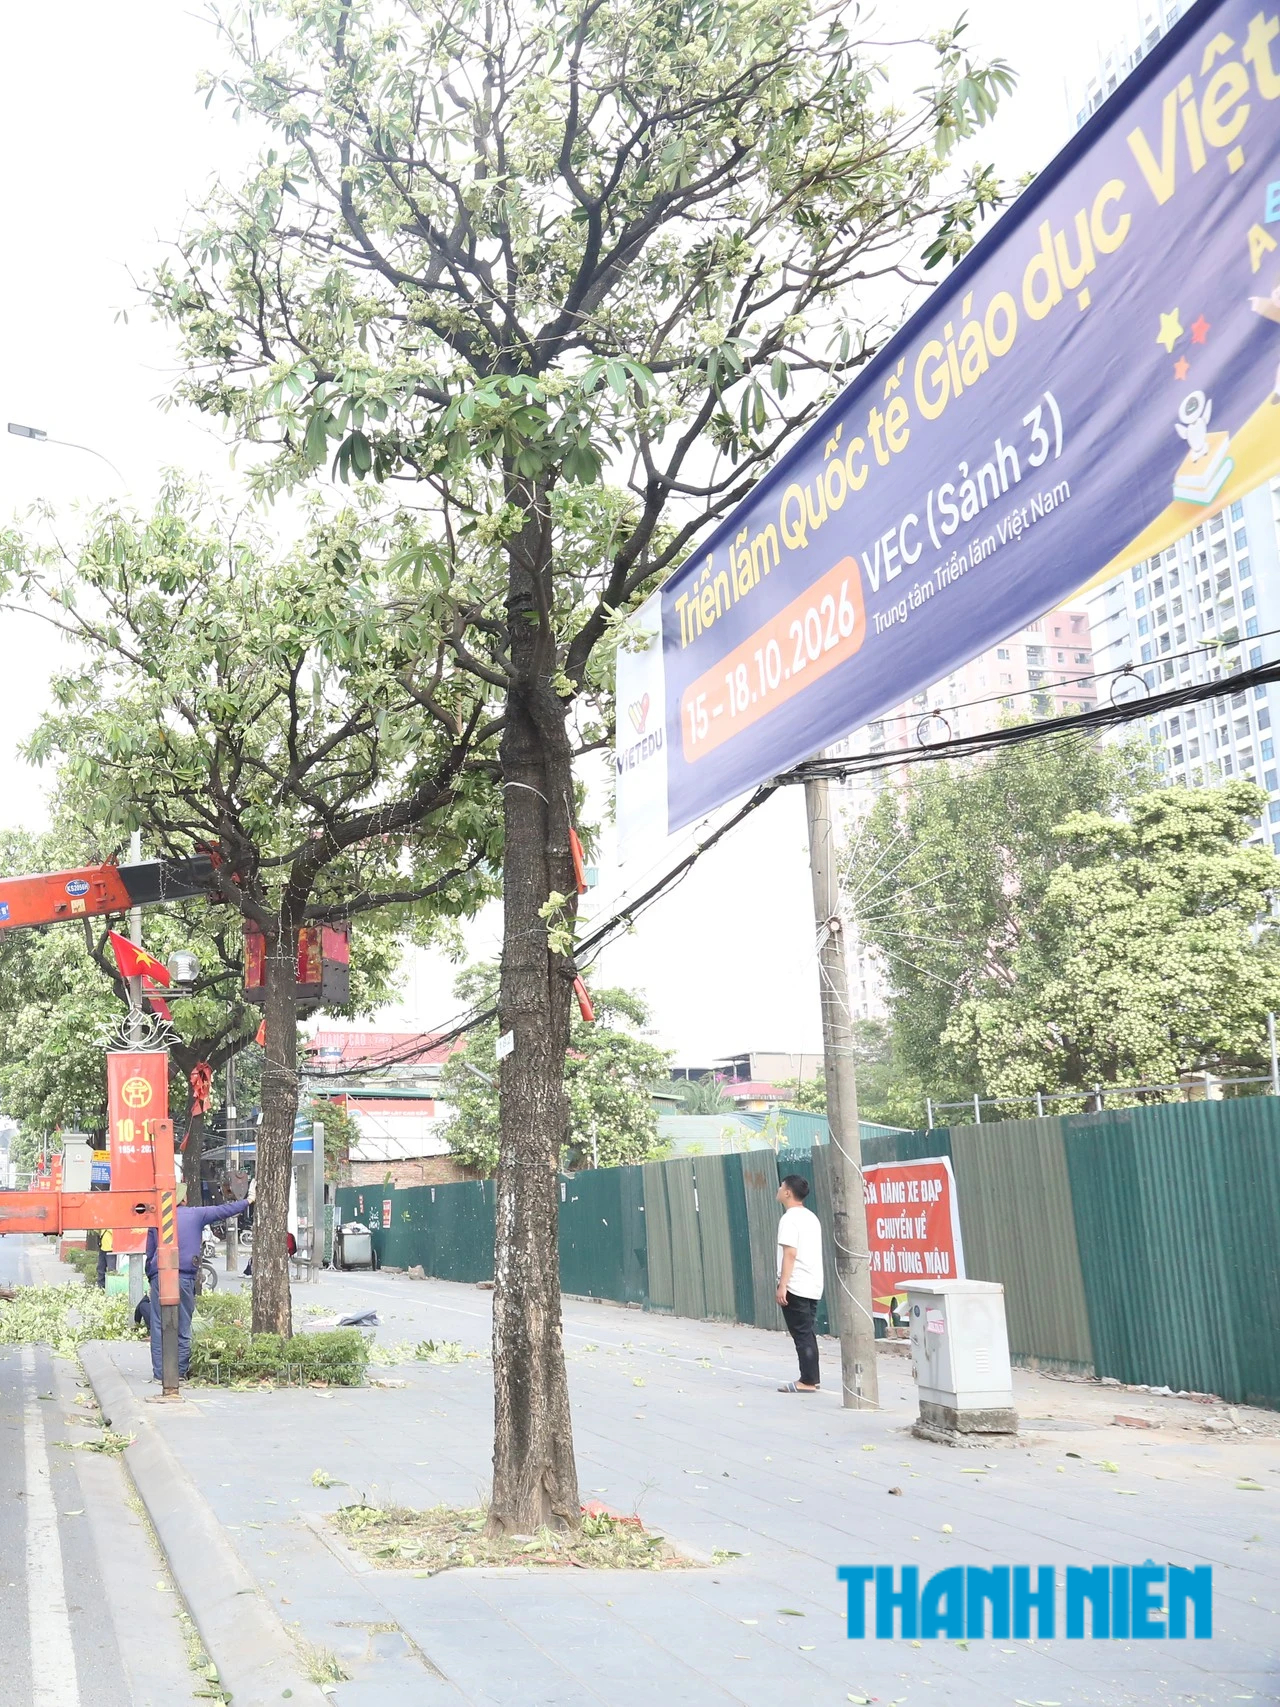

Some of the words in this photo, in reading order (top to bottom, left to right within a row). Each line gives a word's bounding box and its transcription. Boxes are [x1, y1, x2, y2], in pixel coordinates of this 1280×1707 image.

[674, 552, 732, 650] Triển
[728, 525, 781, 603] lãm
[779, 421, 869, 551] Quốc
[867, 356, 911, 467] tế
[914, 289, 1019, 420] Giáo
[1021, 179, 1132, 321] dục
[1125, 10, 1280, 207] Việt
[861, 512, 923, 593] VEC
[926, 437, 1022, 550] (Sảnh
[1022, 390, 1064, 468] 3)
[872, 599, 908, 635] Trung
[908, 579, 935, 611] tâm
[933, 550, 969, 592] Triển
[968, 534, 998, 569] lãm
[996, 508, 1031, 542] Việt
[1030, 479, 1071, 523] Nam
[686, 691, 709, 745] 15
[724, 578, 856, 719] 18.10.2026
[116, 1118, 134, 1143] 10
[118, 1144, 136, 1154] 1954
[880, 1177, 906, 1204] HÀNG
[906, 1181, 920, 1203] XE
[920, 1178, 943, 1207] ĐẠP
[876, 1208, 914, 1240] CHUYỂN
[914, 1209, 928, 1240] VỀ
[896, 1246, 924, 1274] TÙNG
[923, 1246, 950, 1279] MẬU
